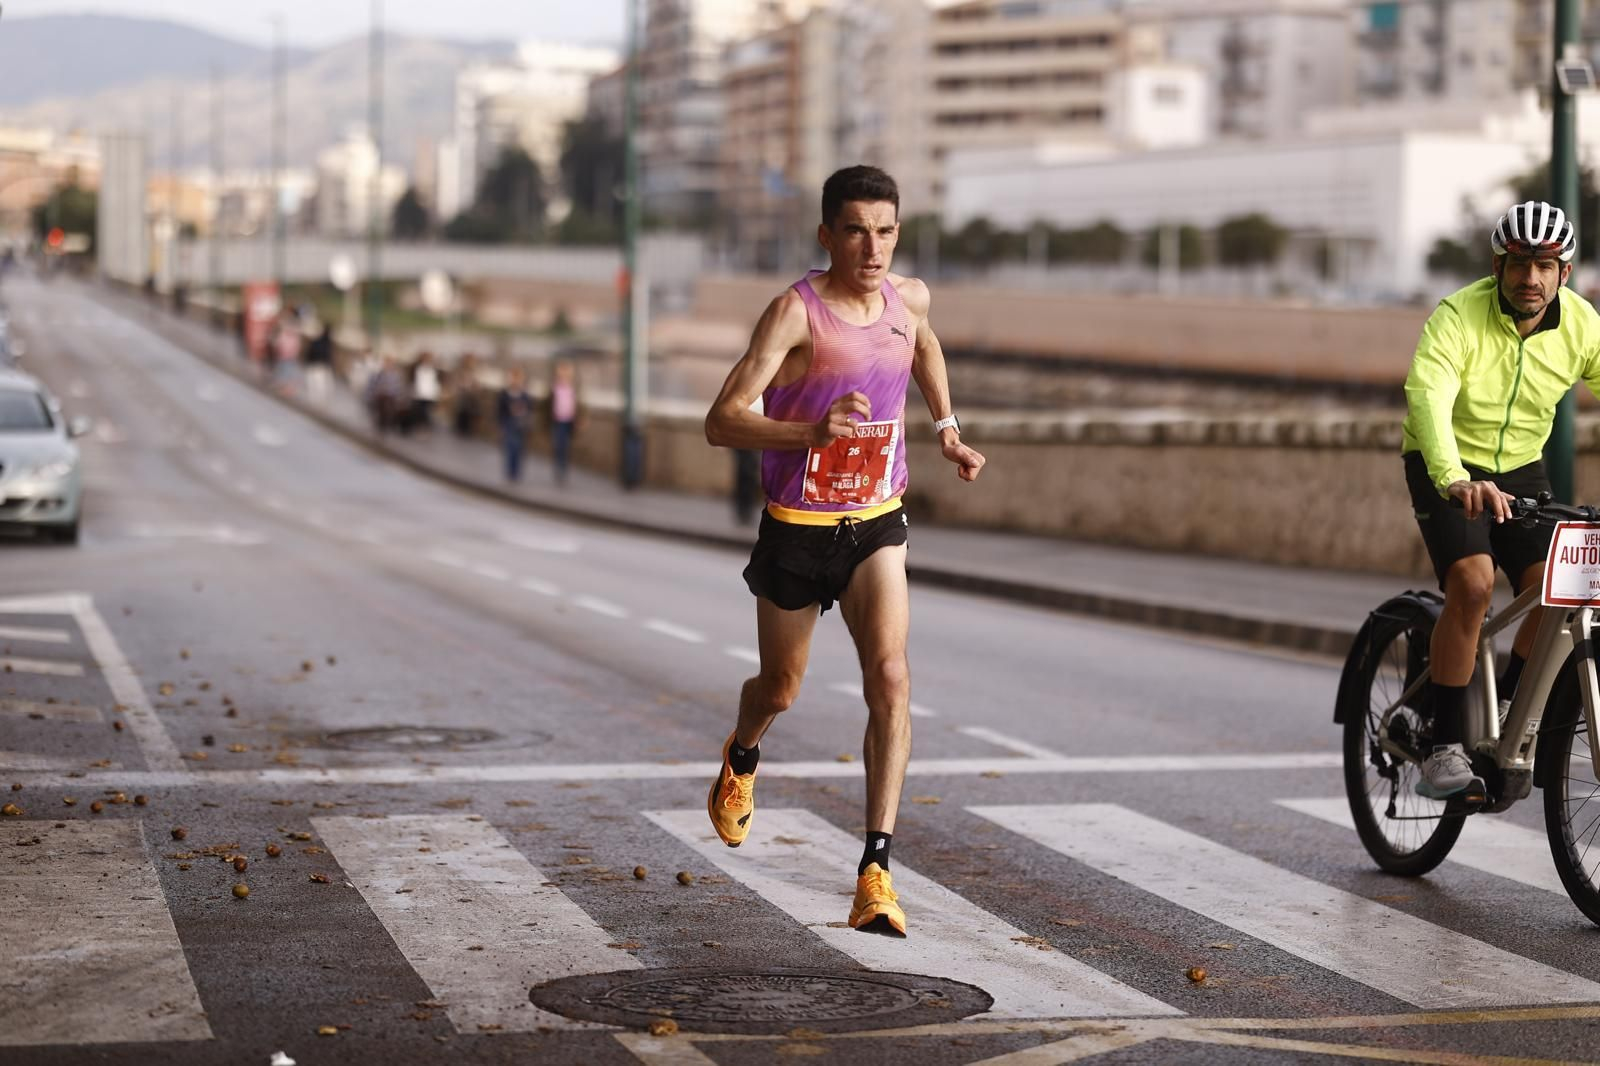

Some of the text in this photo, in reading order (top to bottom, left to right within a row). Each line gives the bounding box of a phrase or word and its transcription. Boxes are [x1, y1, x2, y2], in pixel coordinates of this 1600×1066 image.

[838, 425, 889, 438] NERALI
[848, 447, 860, 456] 26
[1560, 546, 1600, 565] AUTO
